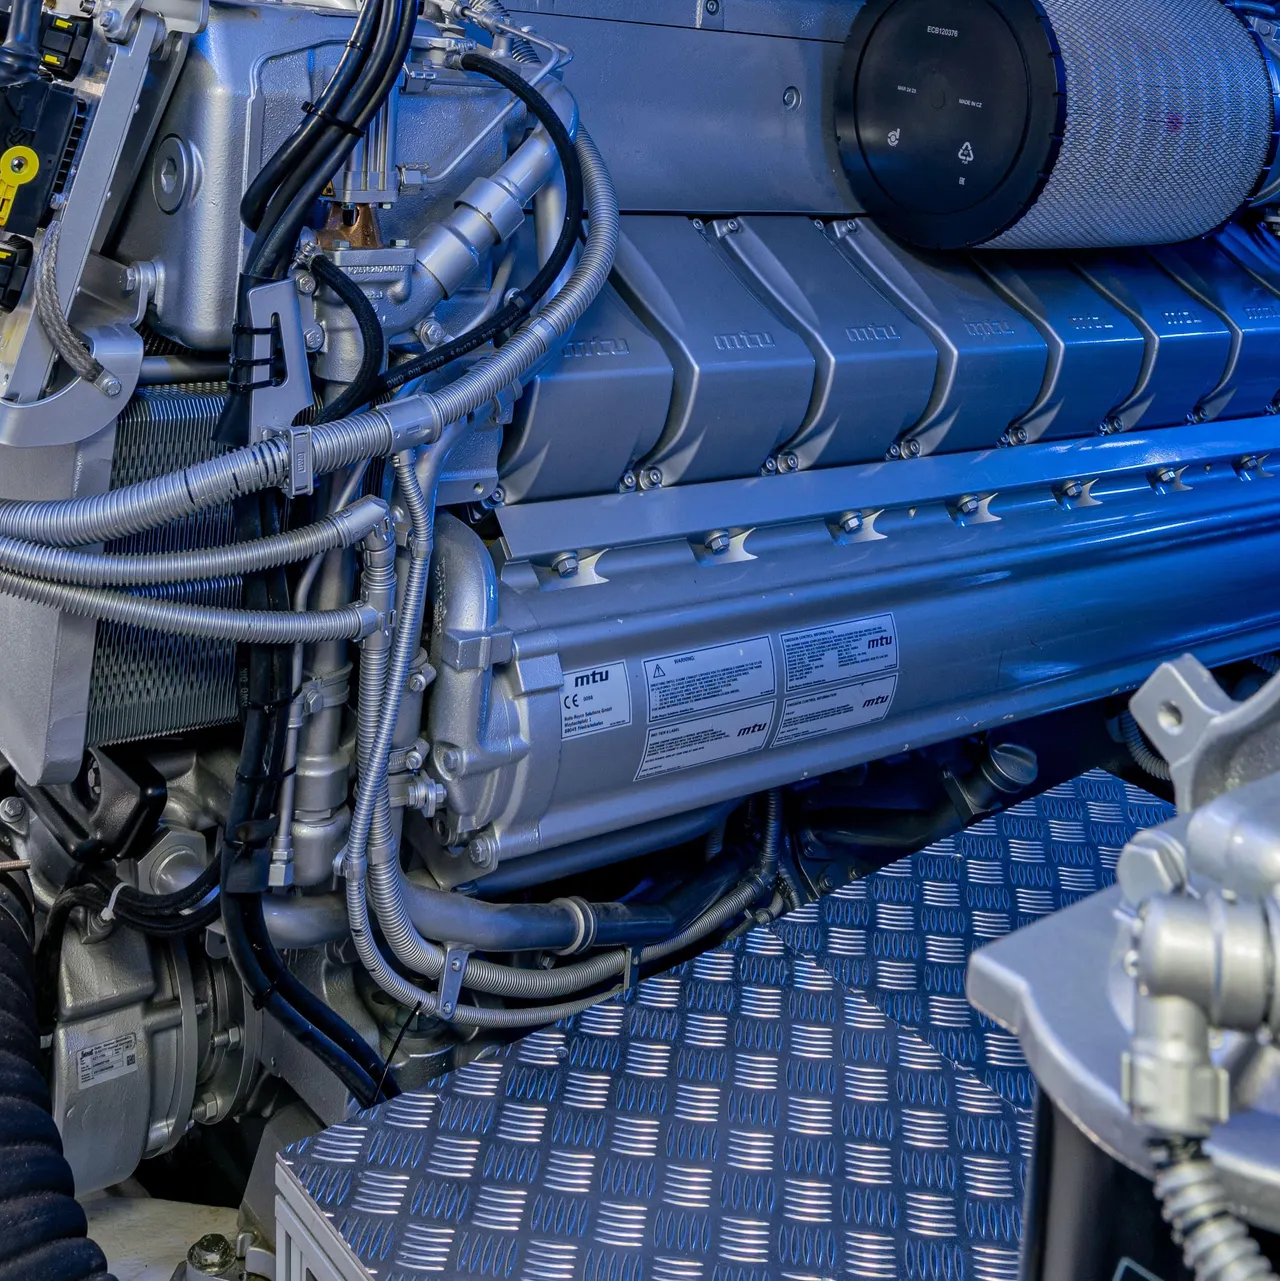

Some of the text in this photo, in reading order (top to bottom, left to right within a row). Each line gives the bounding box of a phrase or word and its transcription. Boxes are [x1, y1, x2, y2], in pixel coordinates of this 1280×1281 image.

[927, 26, 958, 37] ECB120376
[959, 98, 971, 106] MADE
[845, 322, 902, 342] mtu
[964, 318, 1015, 336] mtu
[562, 336, 630, 358] mtu
[714, 330, 776, 350] mtu
[866, 634, 892, 649] mtu
[574, 668, 609, 687] mtu
[862, 693, 889, 708] mtu
[736, 720, 767, 737] mtu
